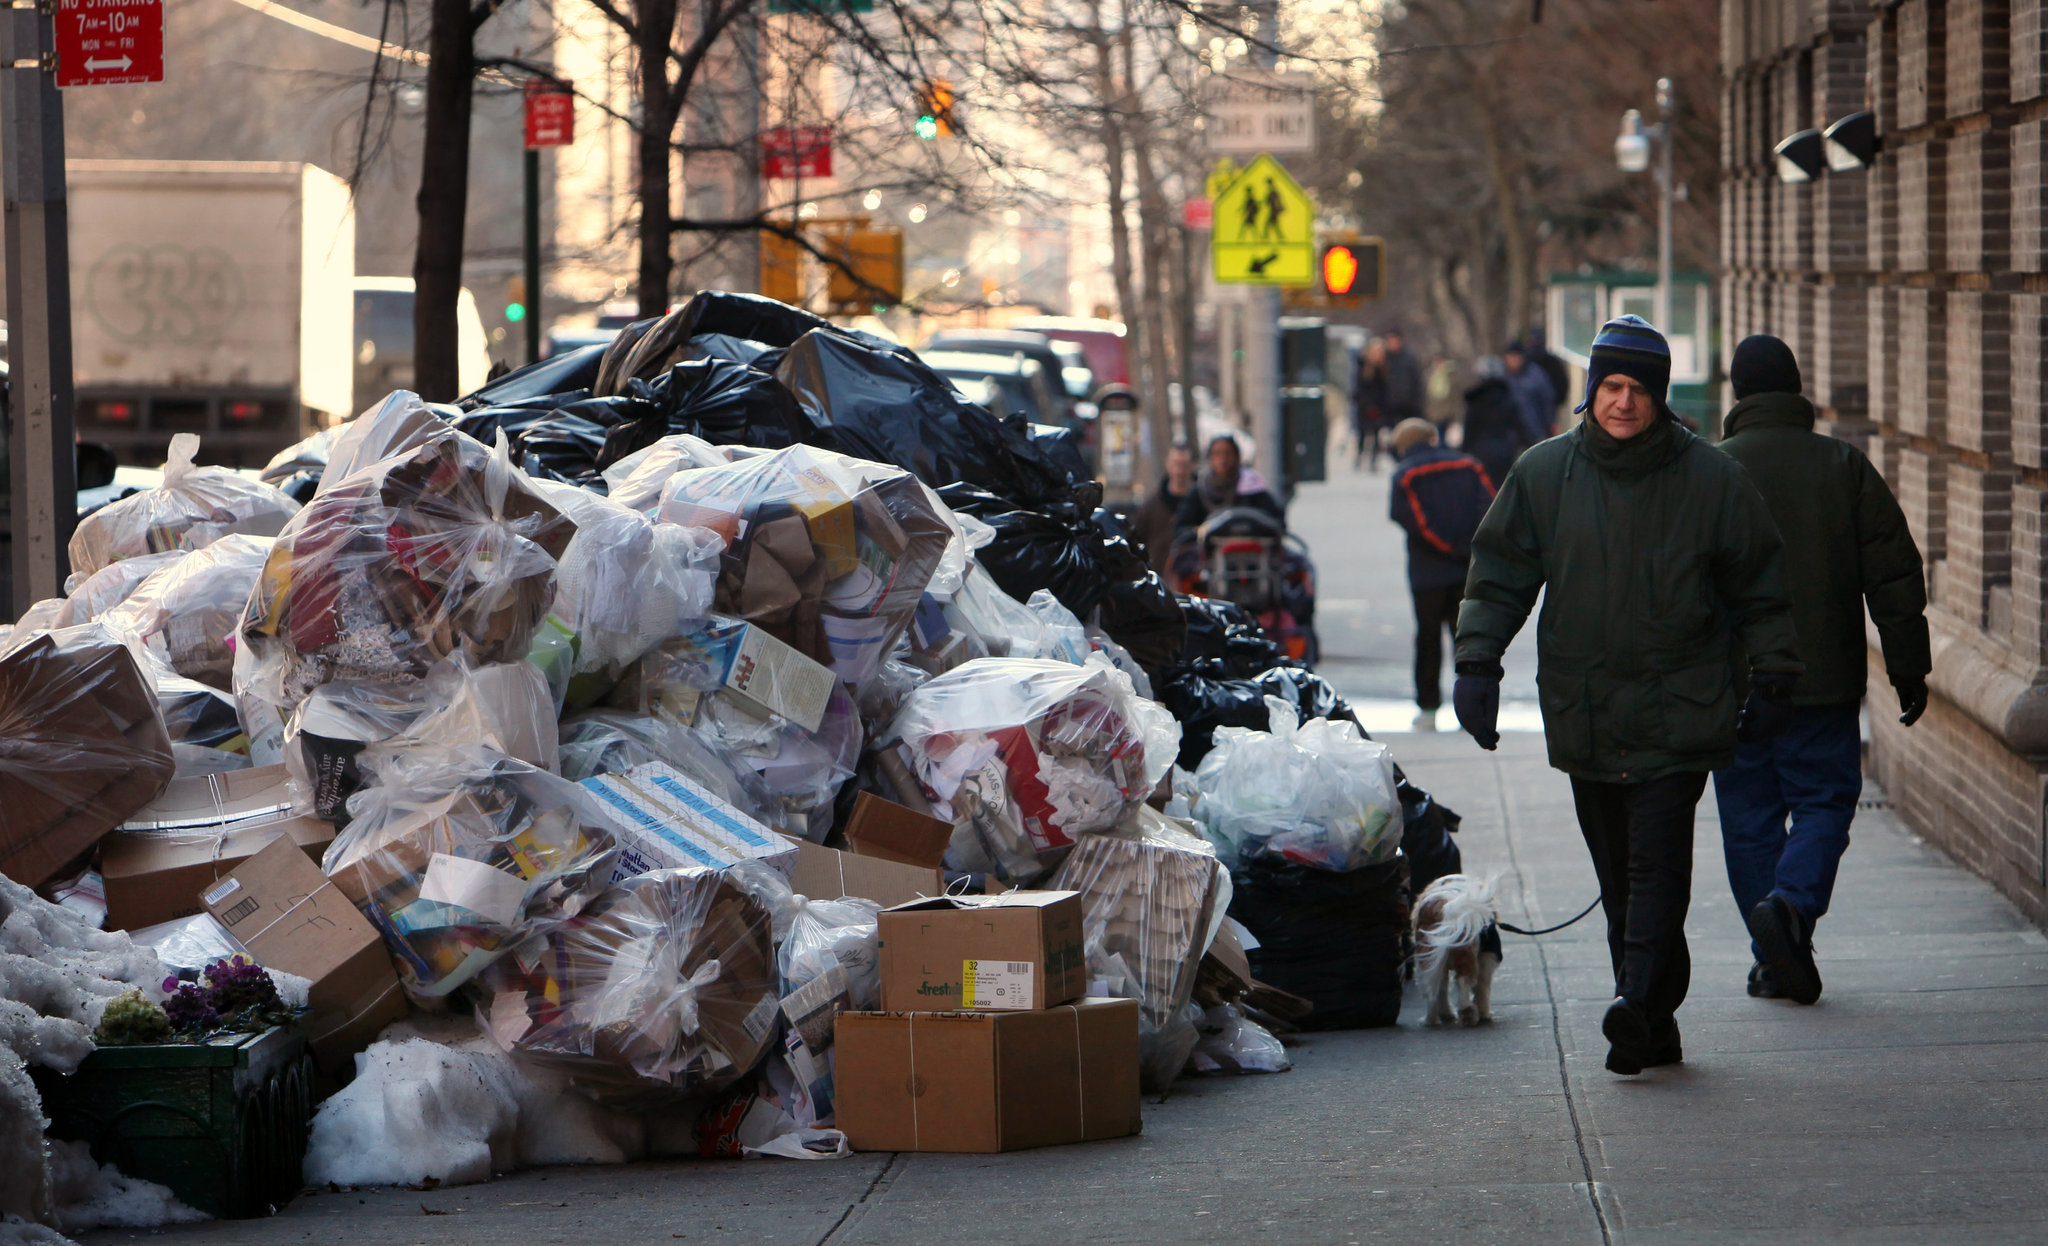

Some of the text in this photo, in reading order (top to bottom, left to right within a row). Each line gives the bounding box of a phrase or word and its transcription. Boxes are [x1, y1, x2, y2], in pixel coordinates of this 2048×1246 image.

[82, 39, 100, 51] MON
[120, 37, 134, 48] FRI
[968, 961, 978, 971] 32
